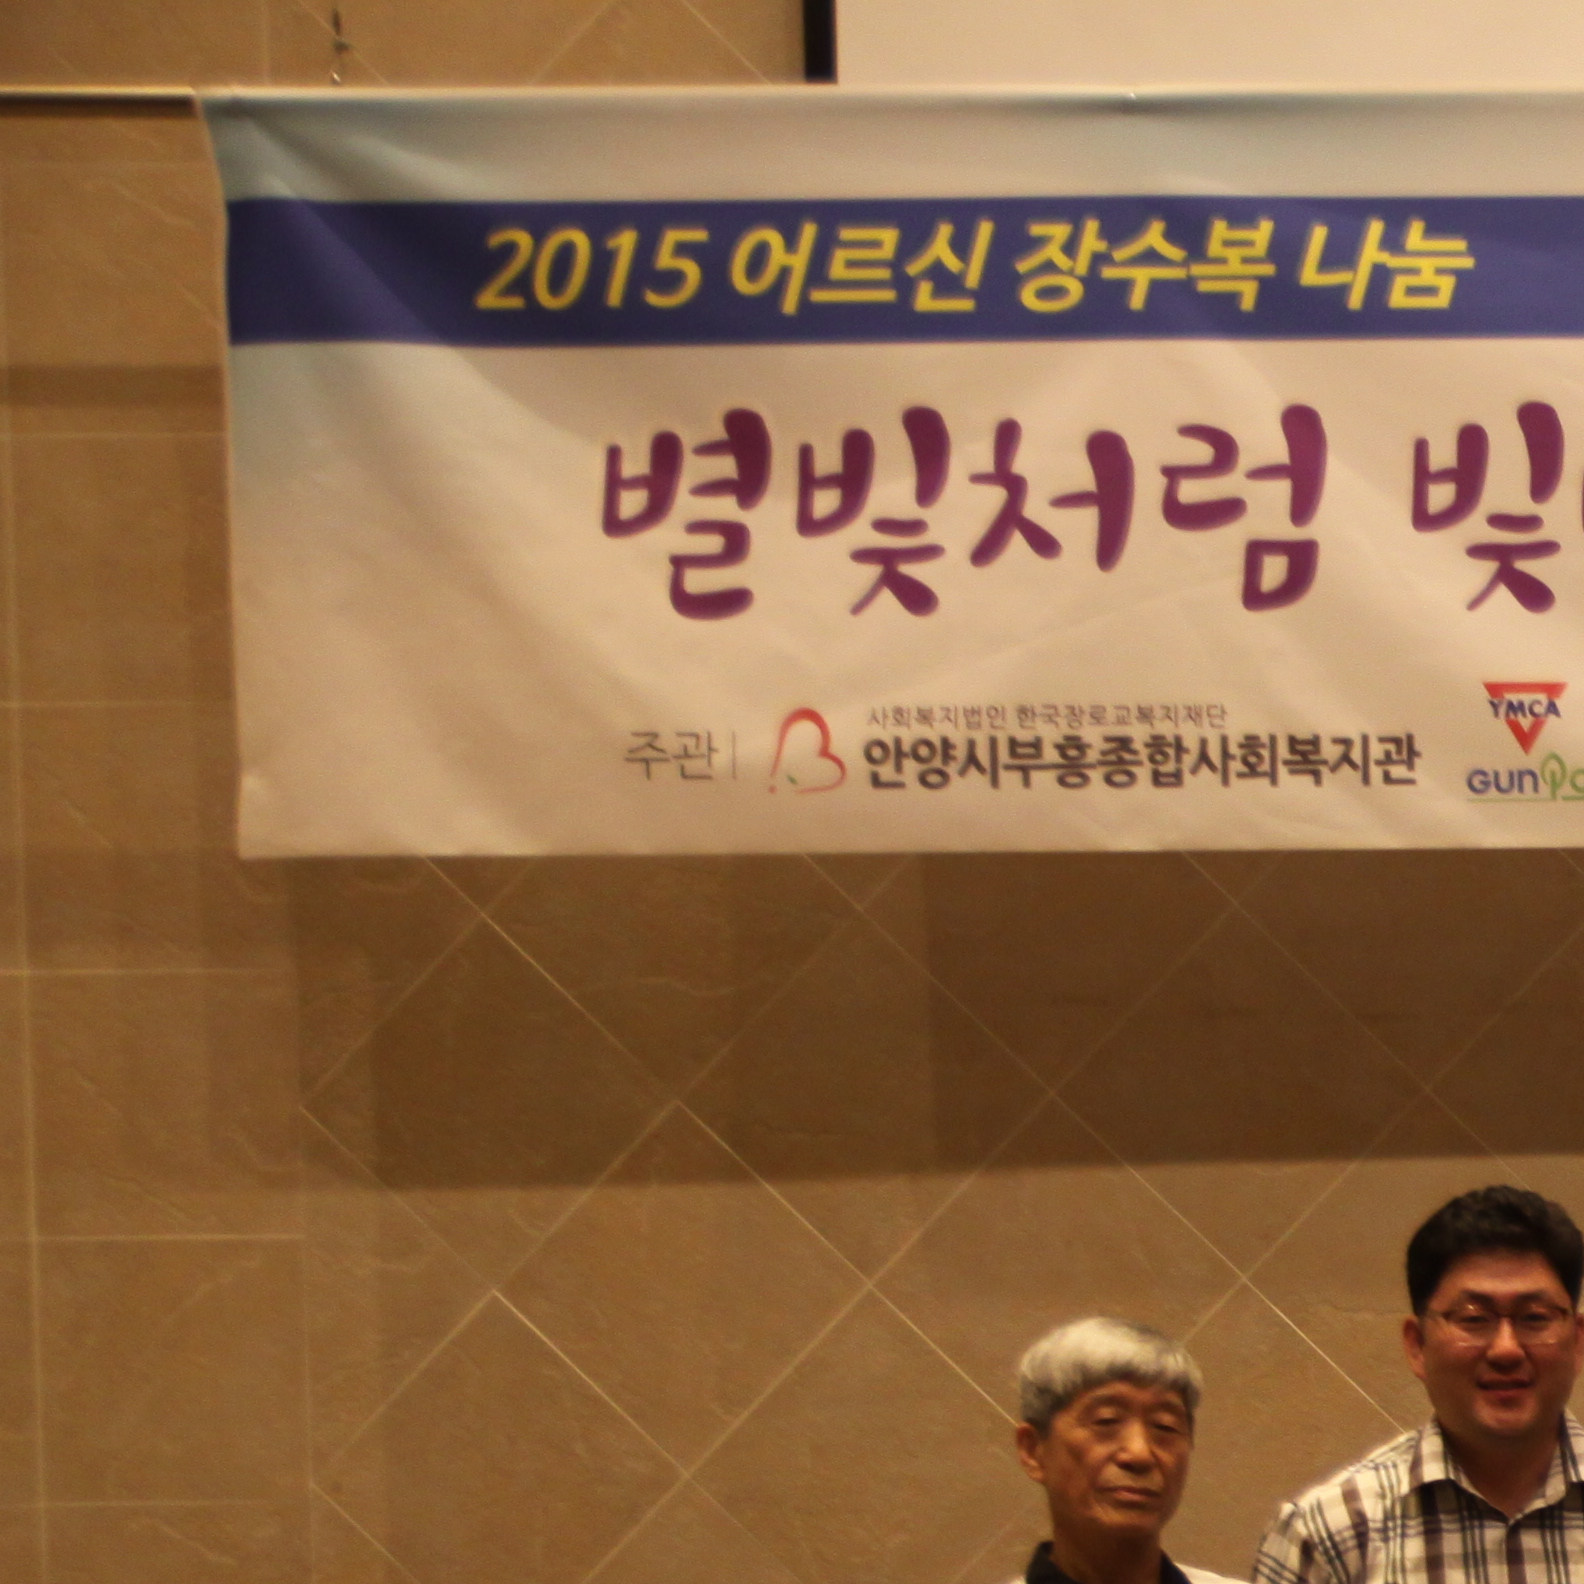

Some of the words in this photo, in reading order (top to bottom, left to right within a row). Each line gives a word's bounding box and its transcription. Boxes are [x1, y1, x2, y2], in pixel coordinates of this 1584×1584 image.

[477, 227, 709, 310] 2015
[730, 219, 995, 315] 어르신
[1015, 219, 1276, 313] 장수복
[1299, 218, 1476, 311] 나눔
[601, 406, 1328, 621] 별빛처럼
[868, 704, 1008, 731] 사회복지법인
[1015, 703, 1228, 730] 한국장로교복지재단
[1488, 698, 1562, 720] YMCA
[624, 731, 719, 782] 주관
[863, 734, 1422, 790] 안양시부흥종합사회복지관
